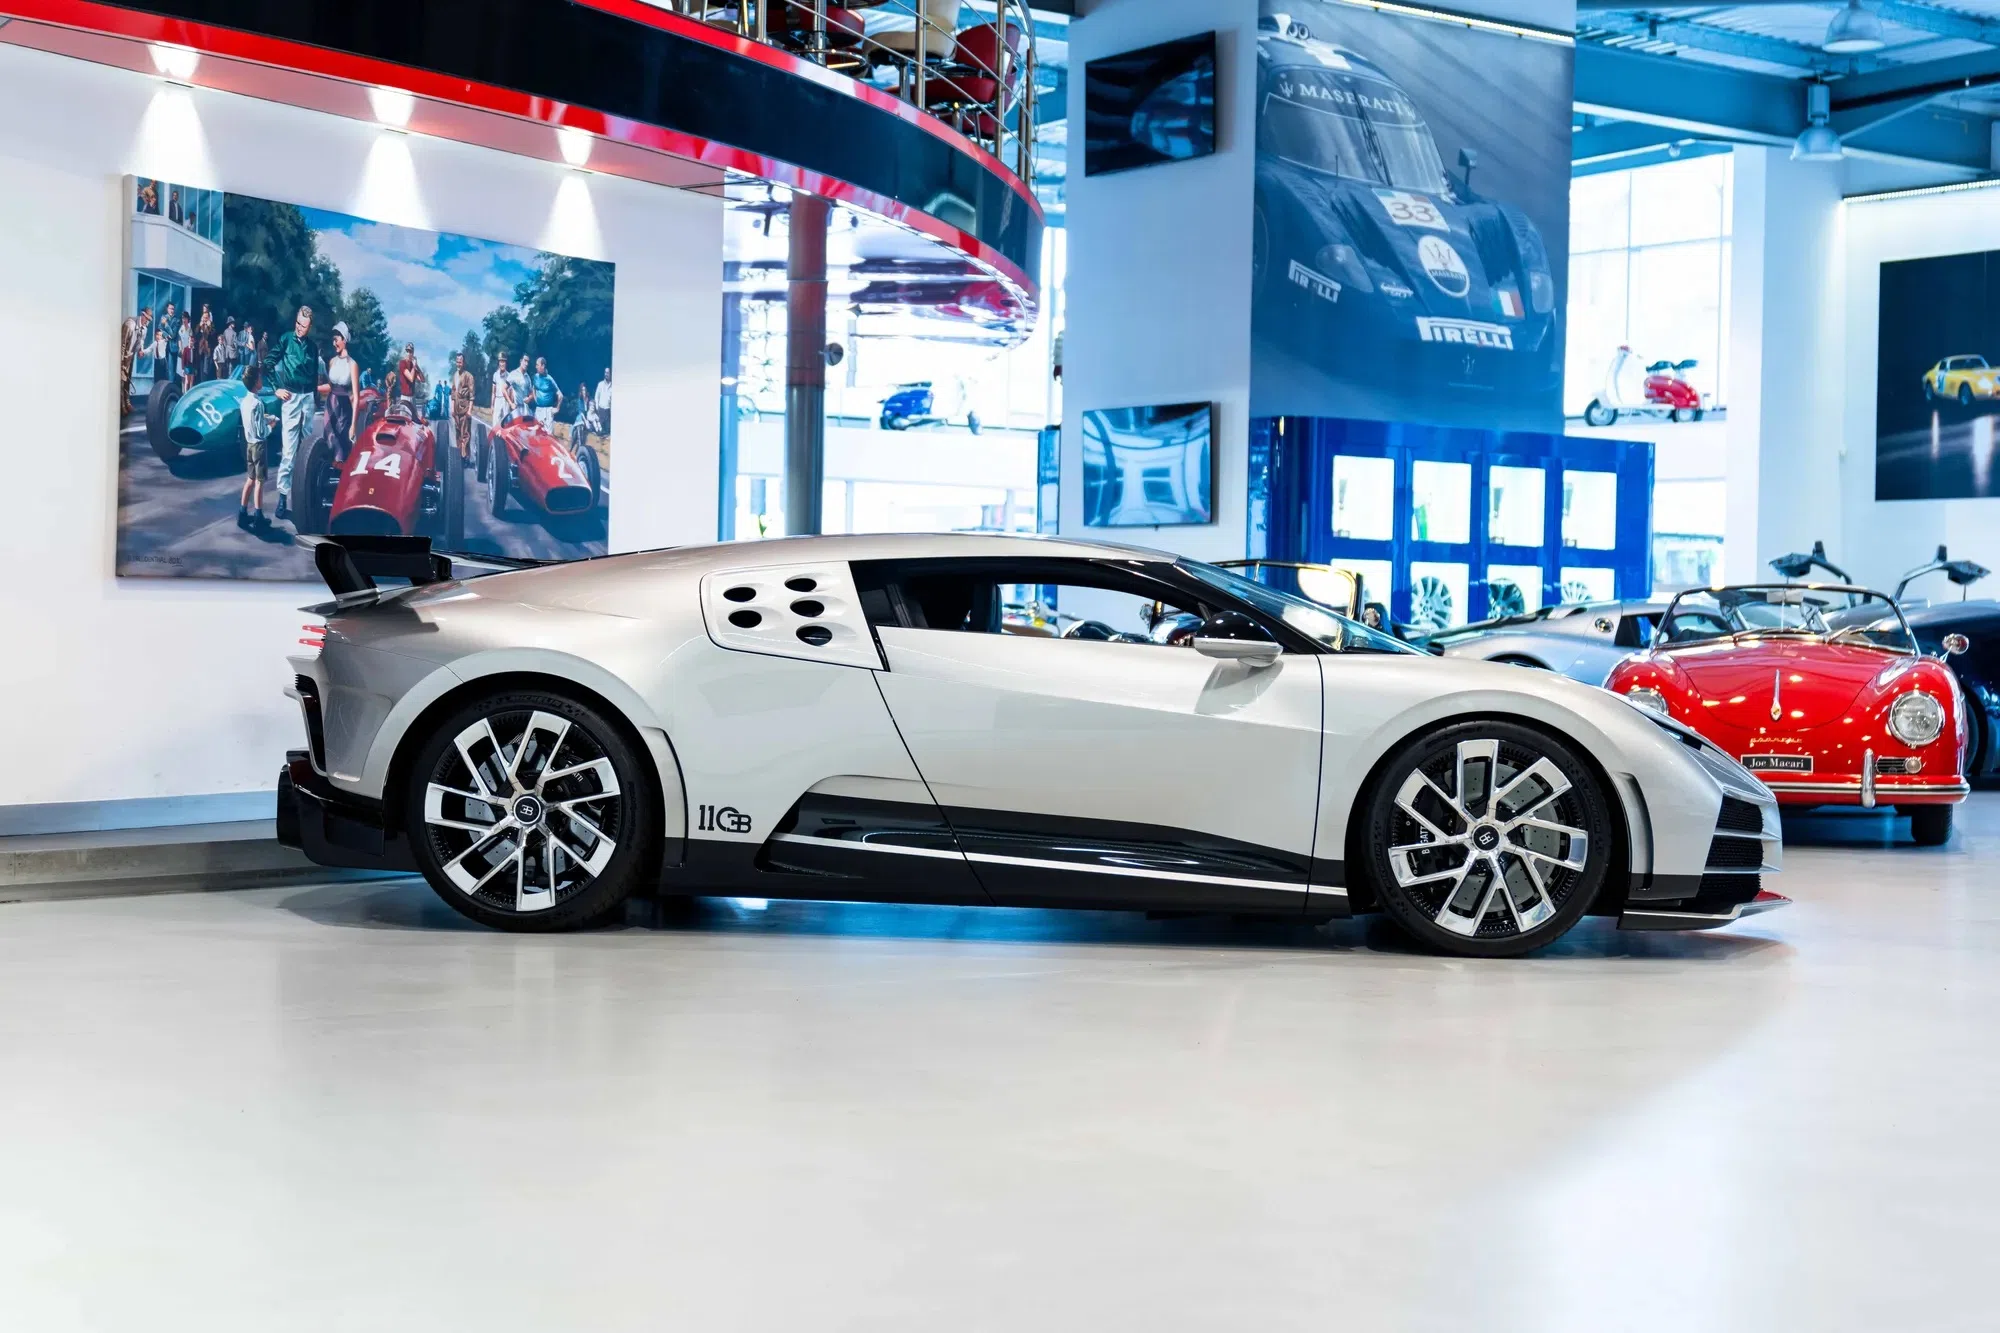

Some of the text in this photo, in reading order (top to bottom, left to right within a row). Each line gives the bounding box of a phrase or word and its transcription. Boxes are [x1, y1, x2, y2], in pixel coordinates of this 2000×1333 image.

[1299, 83, 1403, 116] MASERATI
[1391, 202, 1434, 223] 33
[1288, 259, 1342, 304] PIRLLI
[1416, 316, 1513, 351] PIRELLI
[195, 402, 223, 427] 18
[350, 451, 401, 480] 14
[1750, 757, 1804, 769] Joe Macari
[1420, 825, 1430, 855] BGATT
